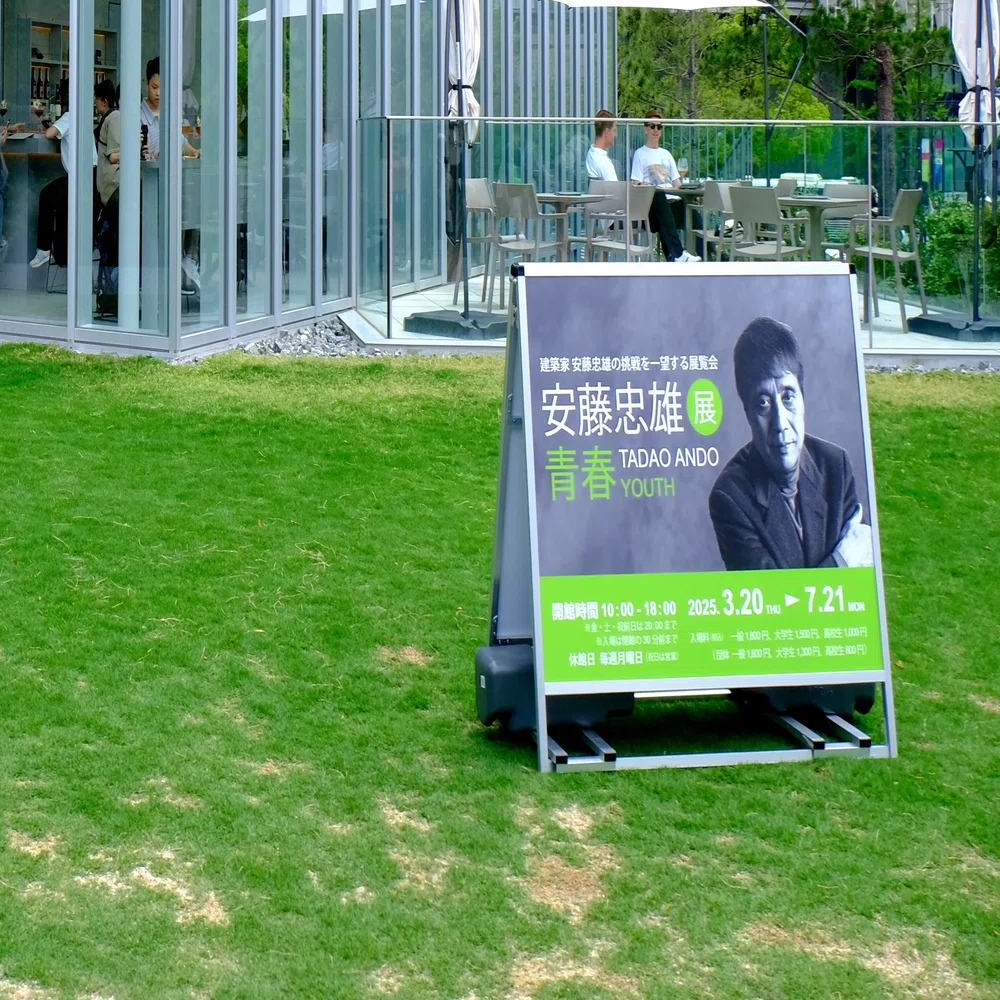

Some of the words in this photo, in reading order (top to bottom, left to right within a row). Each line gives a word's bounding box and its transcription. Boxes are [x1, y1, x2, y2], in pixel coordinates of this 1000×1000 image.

[539, 356, 570, 373] 建築家
[541, 380, 685, 437] 安藤忠雄
[618, 447, 672, 468] TADAO
[674, 446, 720, 467] ANDO
[545, 445, 616, 501] 青春
[620, 477, 676, 498] YOUTH
[721, 587, 764, 616] 3.20
[765, 604, 781, 615] THU
[804, 584, 845, 613] 7.21
[847, 601, 865, 612] MON
